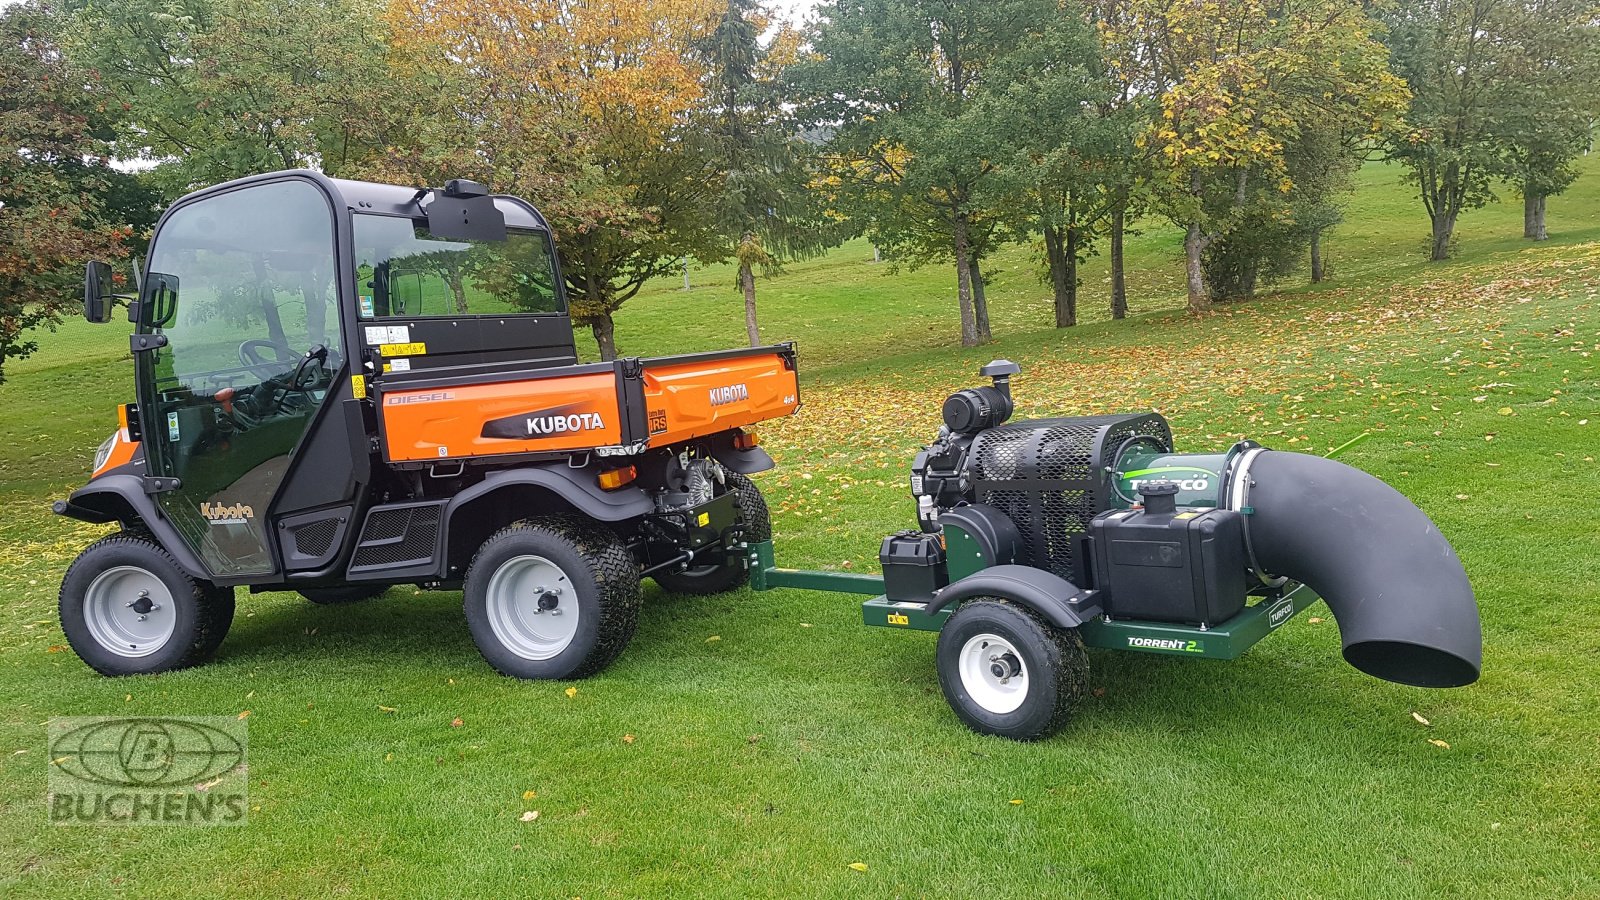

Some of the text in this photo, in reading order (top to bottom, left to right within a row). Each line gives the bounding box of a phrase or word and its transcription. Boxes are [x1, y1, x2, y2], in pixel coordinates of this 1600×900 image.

[388, 392, 455, 405] DIESEL
[709, 383, 749, 406] KUBOTA
[526, 412, 605, 435] KUBOTA
[1129, 479, 1208, 491] TCO
[200, 501, 254, 520] Kubota
[1271, 604, 1292, 623] TURFCO
[1127, 637, 1197, 652] TORRENT 2
